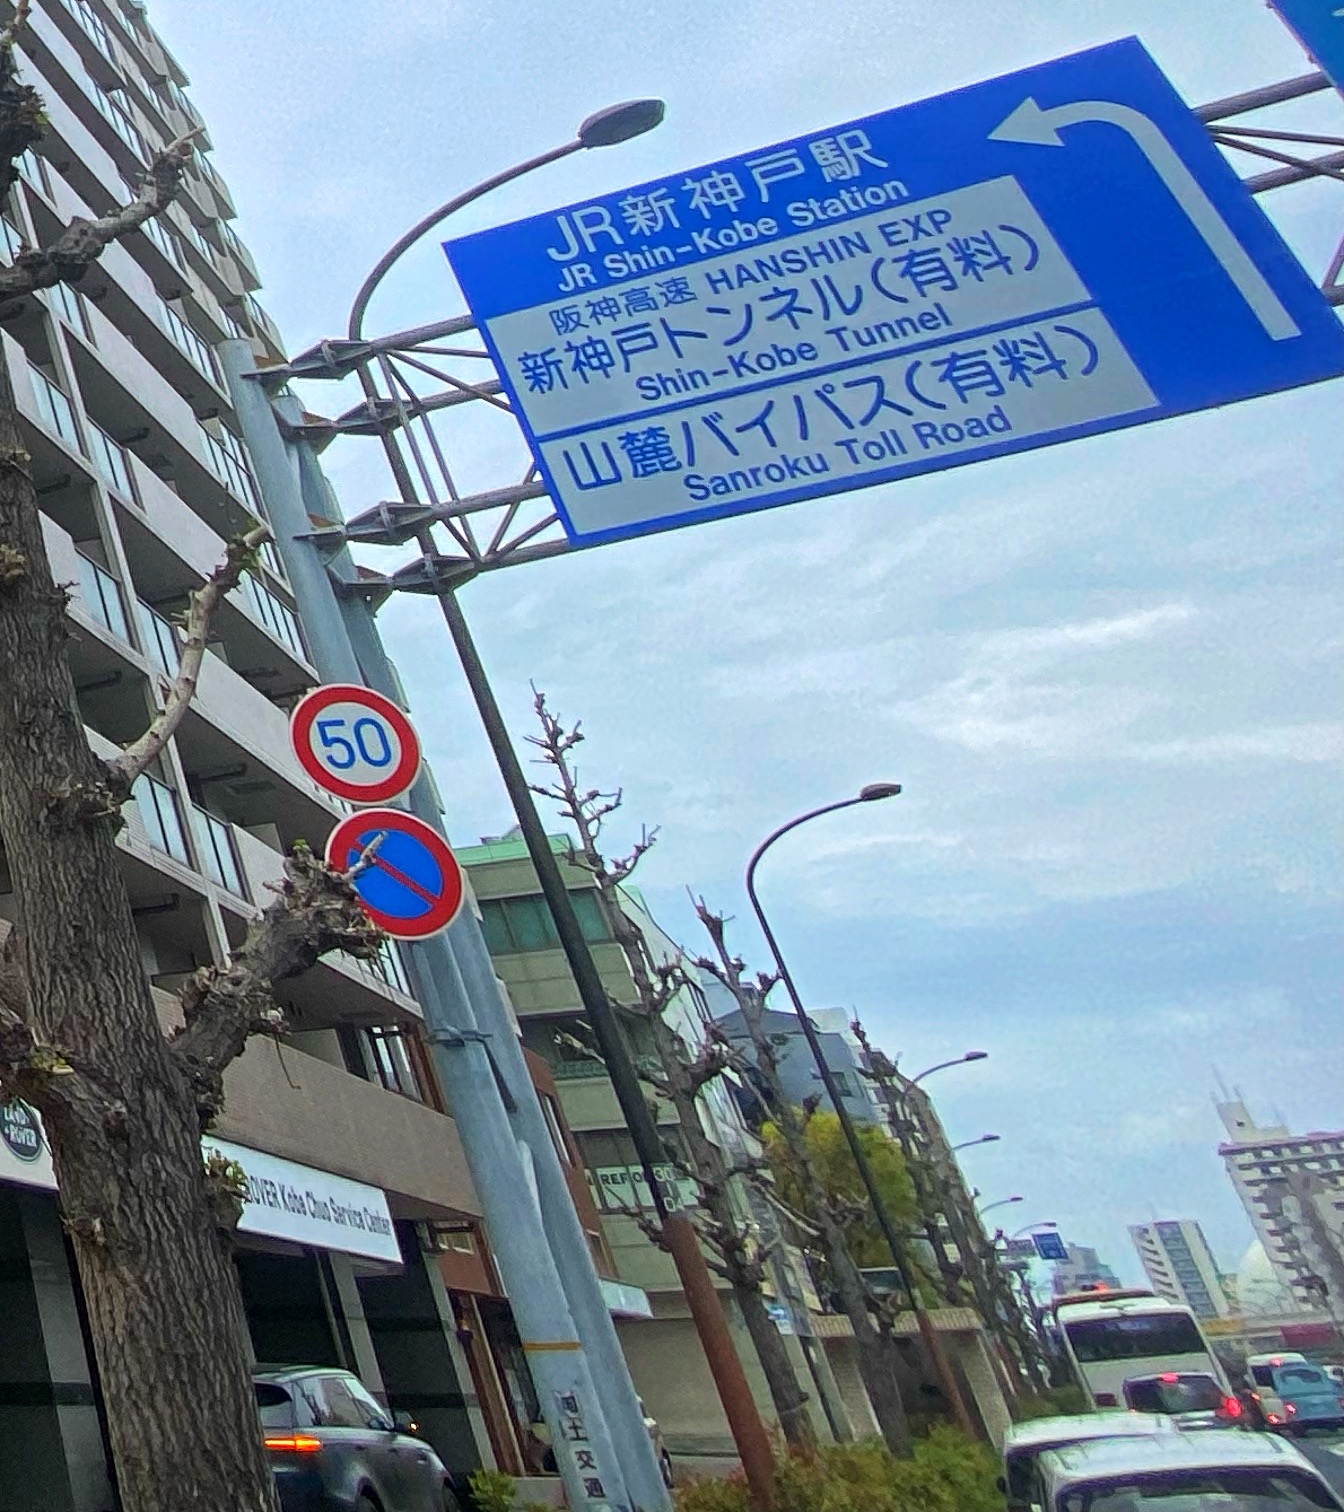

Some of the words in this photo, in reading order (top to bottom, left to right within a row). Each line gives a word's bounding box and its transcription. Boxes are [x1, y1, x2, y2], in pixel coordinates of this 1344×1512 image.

[547, 129, 888, 262] JR新神戸駅
[558, 262, 597, 293] JR
[603, 217, 778, 279] Shin-Kobe
[786, 180, 909, 228] Station
[549, 275, 698, 336] 阪神高速
[705, 230, 872, 295] HANSHIN
[878, 208, 954, 248] EXP
[636, 338, 819, 402] Shin-Kobe
[826, 302, 953, 354] Tunnel
[683, 446, 830, 501] Sanroku
[836, 427, 908, 467] Toll
[920, 405, 1013, 451] Road
[316, 717, 392, 770] 50
[246, 1175, 281, 1210] OVER
